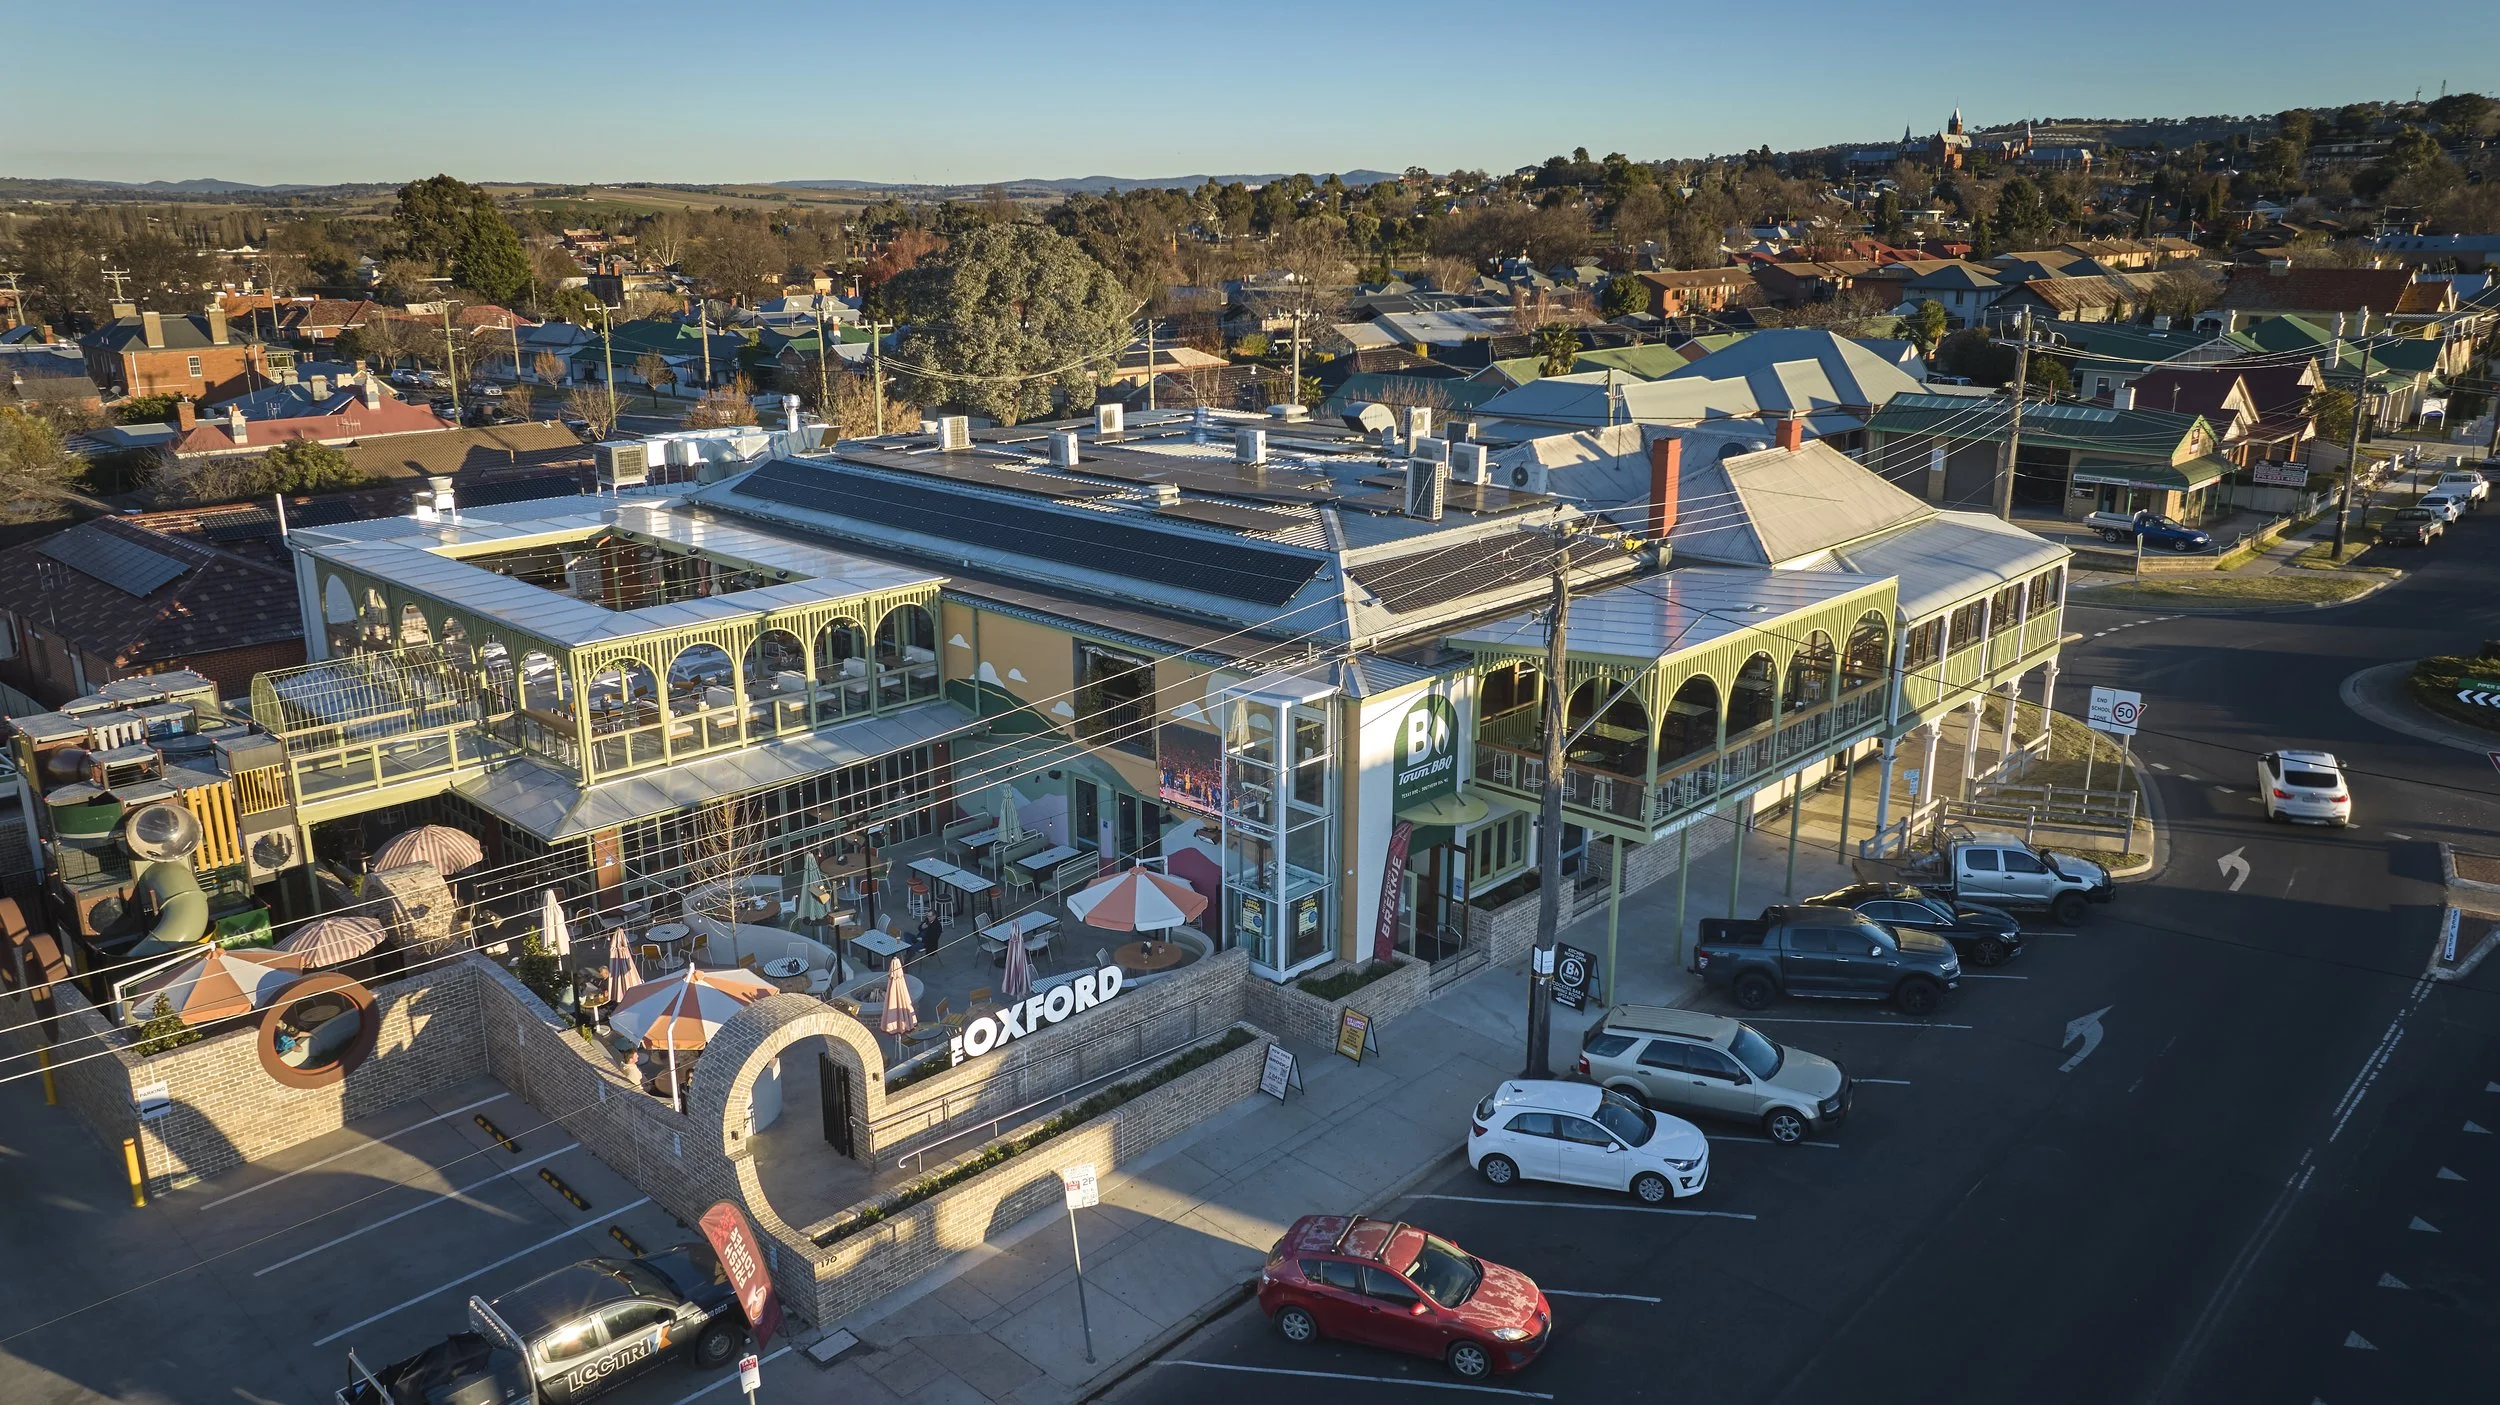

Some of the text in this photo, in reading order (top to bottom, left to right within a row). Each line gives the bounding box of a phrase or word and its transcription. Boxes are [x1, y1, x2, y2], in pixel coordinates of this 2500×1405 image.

[2091, 705, 2111, 713] SCHOOL
[2117, 707, 2133, 719] 50
[1431, 754, 1453, 774] BBQ
[1654, 819, 1686, 841] SPORTS
[1381, 855, 1402, 938] BREKKIE
[963, 965, 1123, 1057] OXFORD
[140, 1086, 166, 1098] PARKING
[1082, 1176, 1095, 1187] 2P
[729, 1226, 756, 1279] COFFEE
[724, 1242, 748, 1289] FRESH
